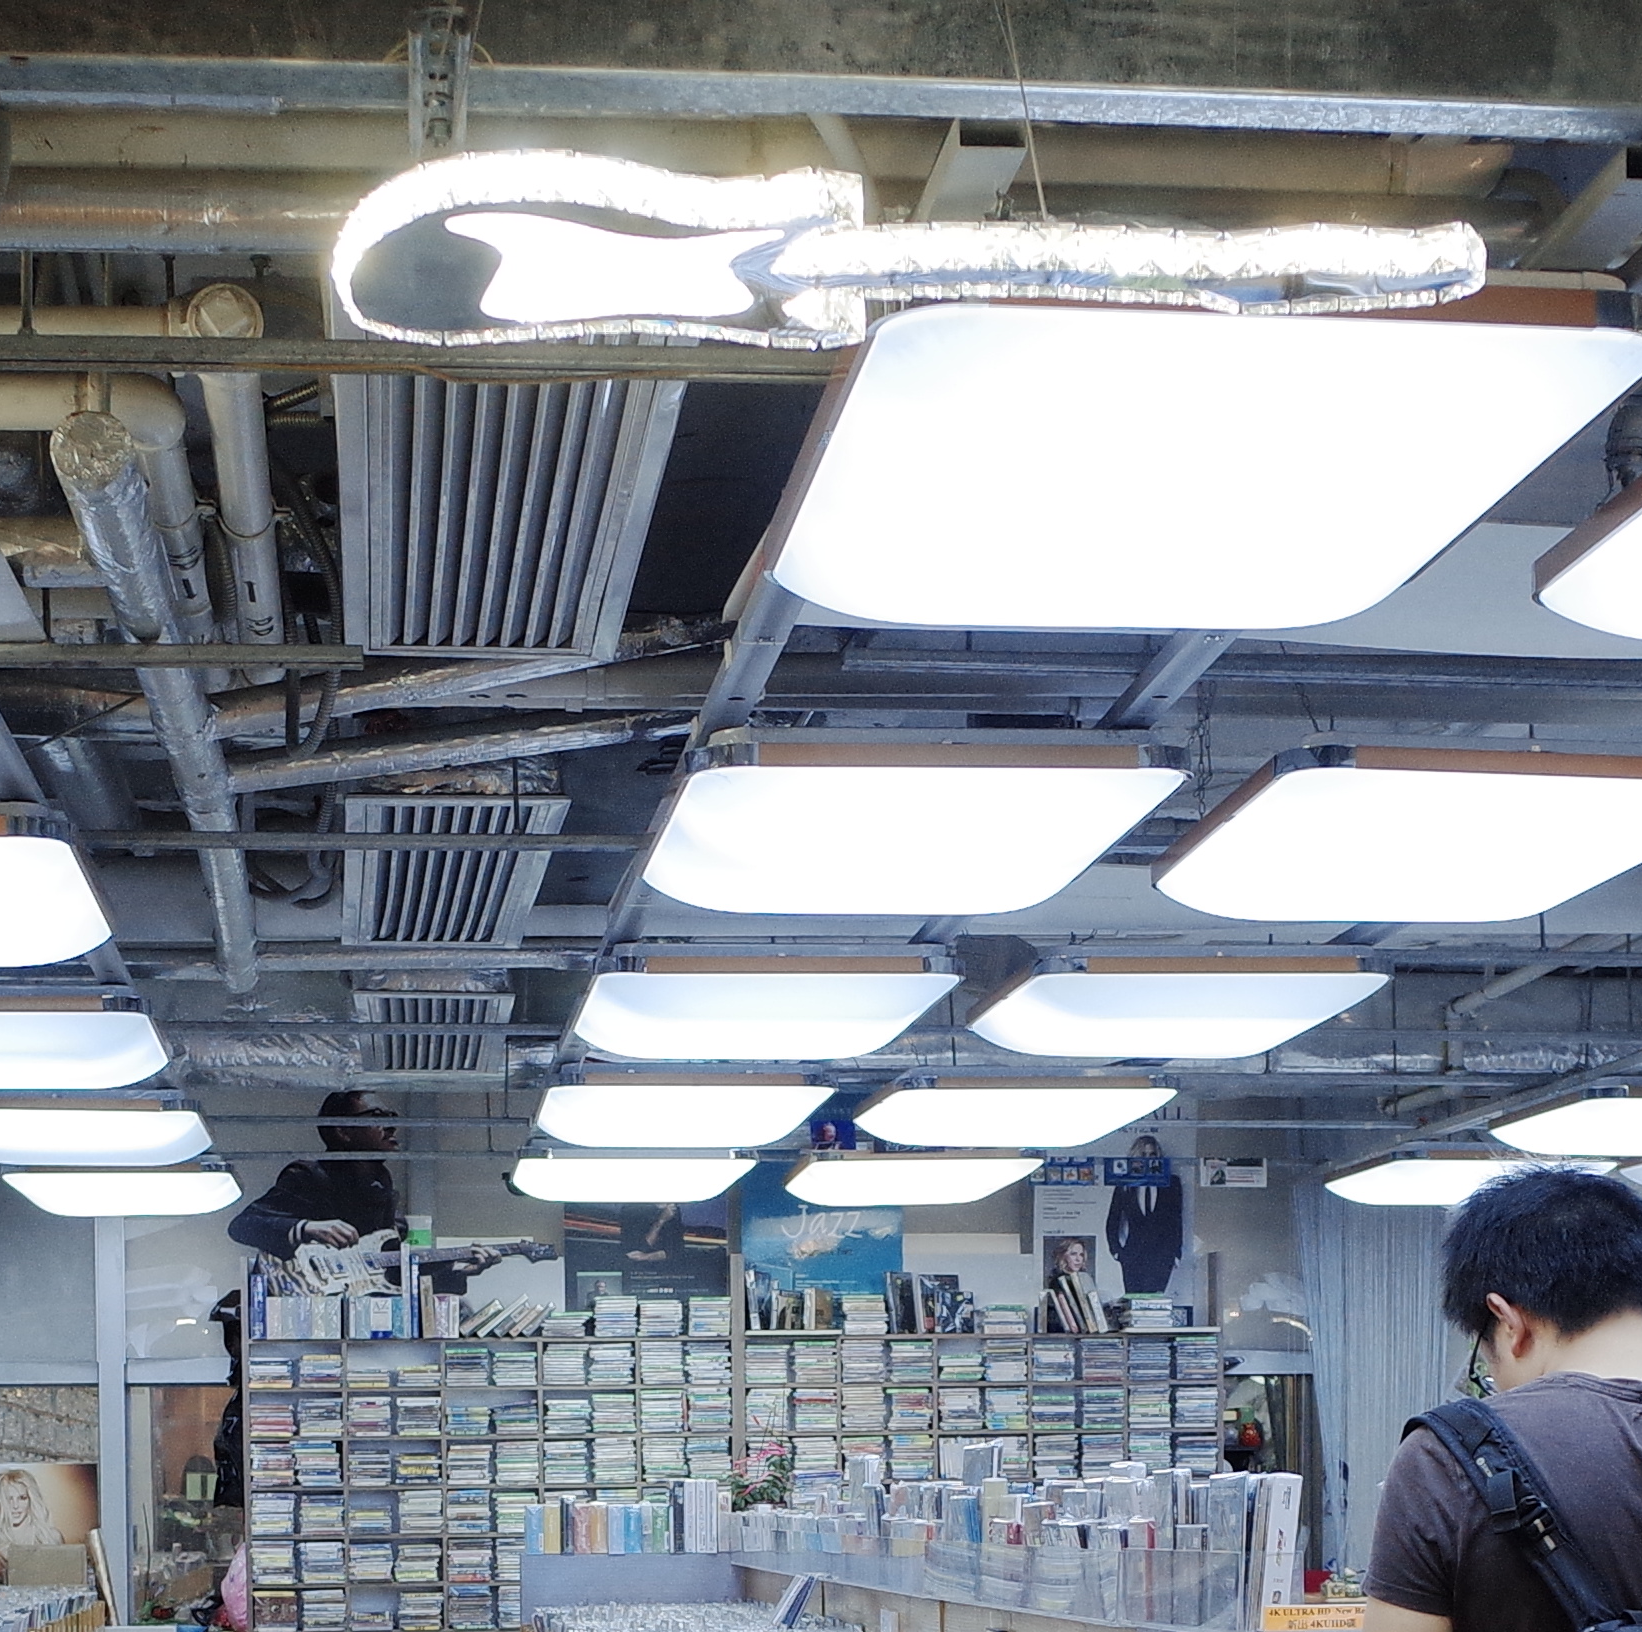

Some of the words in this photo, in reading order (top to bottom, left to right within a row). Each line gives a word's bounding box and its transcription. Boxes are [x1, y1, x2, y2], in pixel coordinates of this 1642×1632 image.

[781, 1204, 864, 1239] Jazz
[1268, 1608, 1281, 1617] 4K
[1283, 1608, 1315, 1617] ULTRA
[1318, 1607, 1331, 1616] HD
[1335, 1607, 1352, 1616] New
